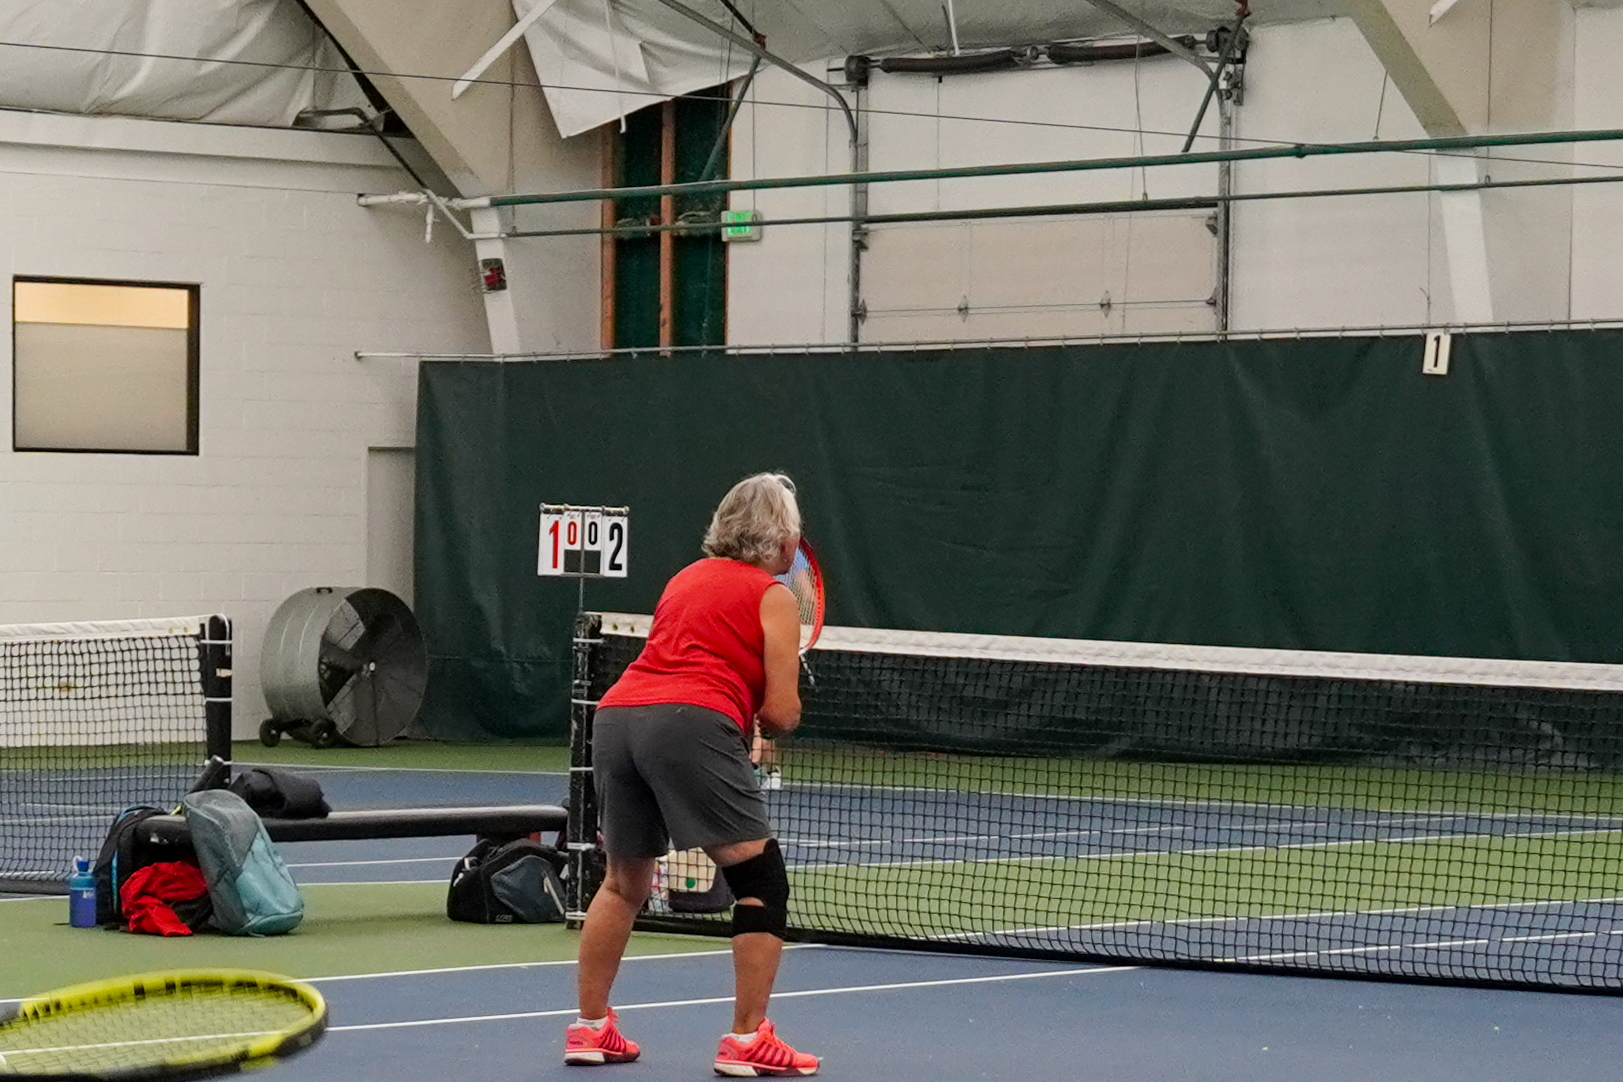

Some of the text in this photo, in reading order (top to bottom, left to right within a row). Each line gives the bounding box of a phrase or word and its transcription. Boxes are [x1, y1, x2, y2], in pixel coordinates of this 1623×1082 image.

[1433, 335, 1441, 368] 1
[549, 520, 623, 571] 1 0 0 2
